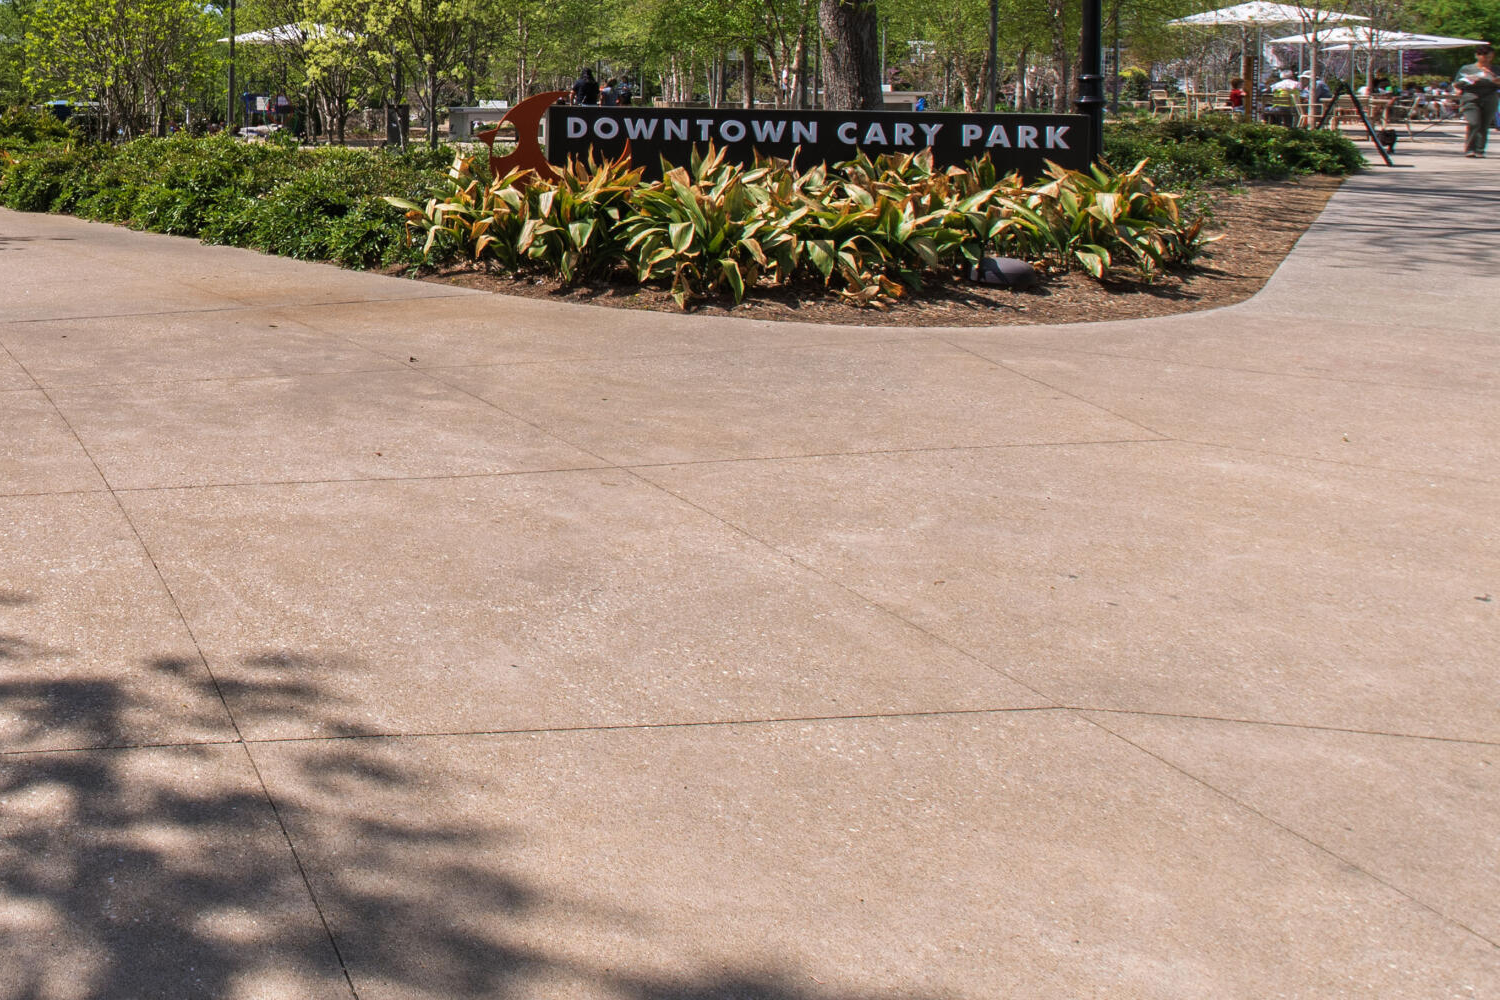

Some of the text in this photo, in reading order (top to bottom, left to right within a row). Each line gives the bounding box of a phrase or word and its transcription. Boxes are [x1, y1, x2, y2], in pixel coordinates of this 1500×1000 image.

[567, 117, 1070, 149] DOWNTOWN CARY PARK
